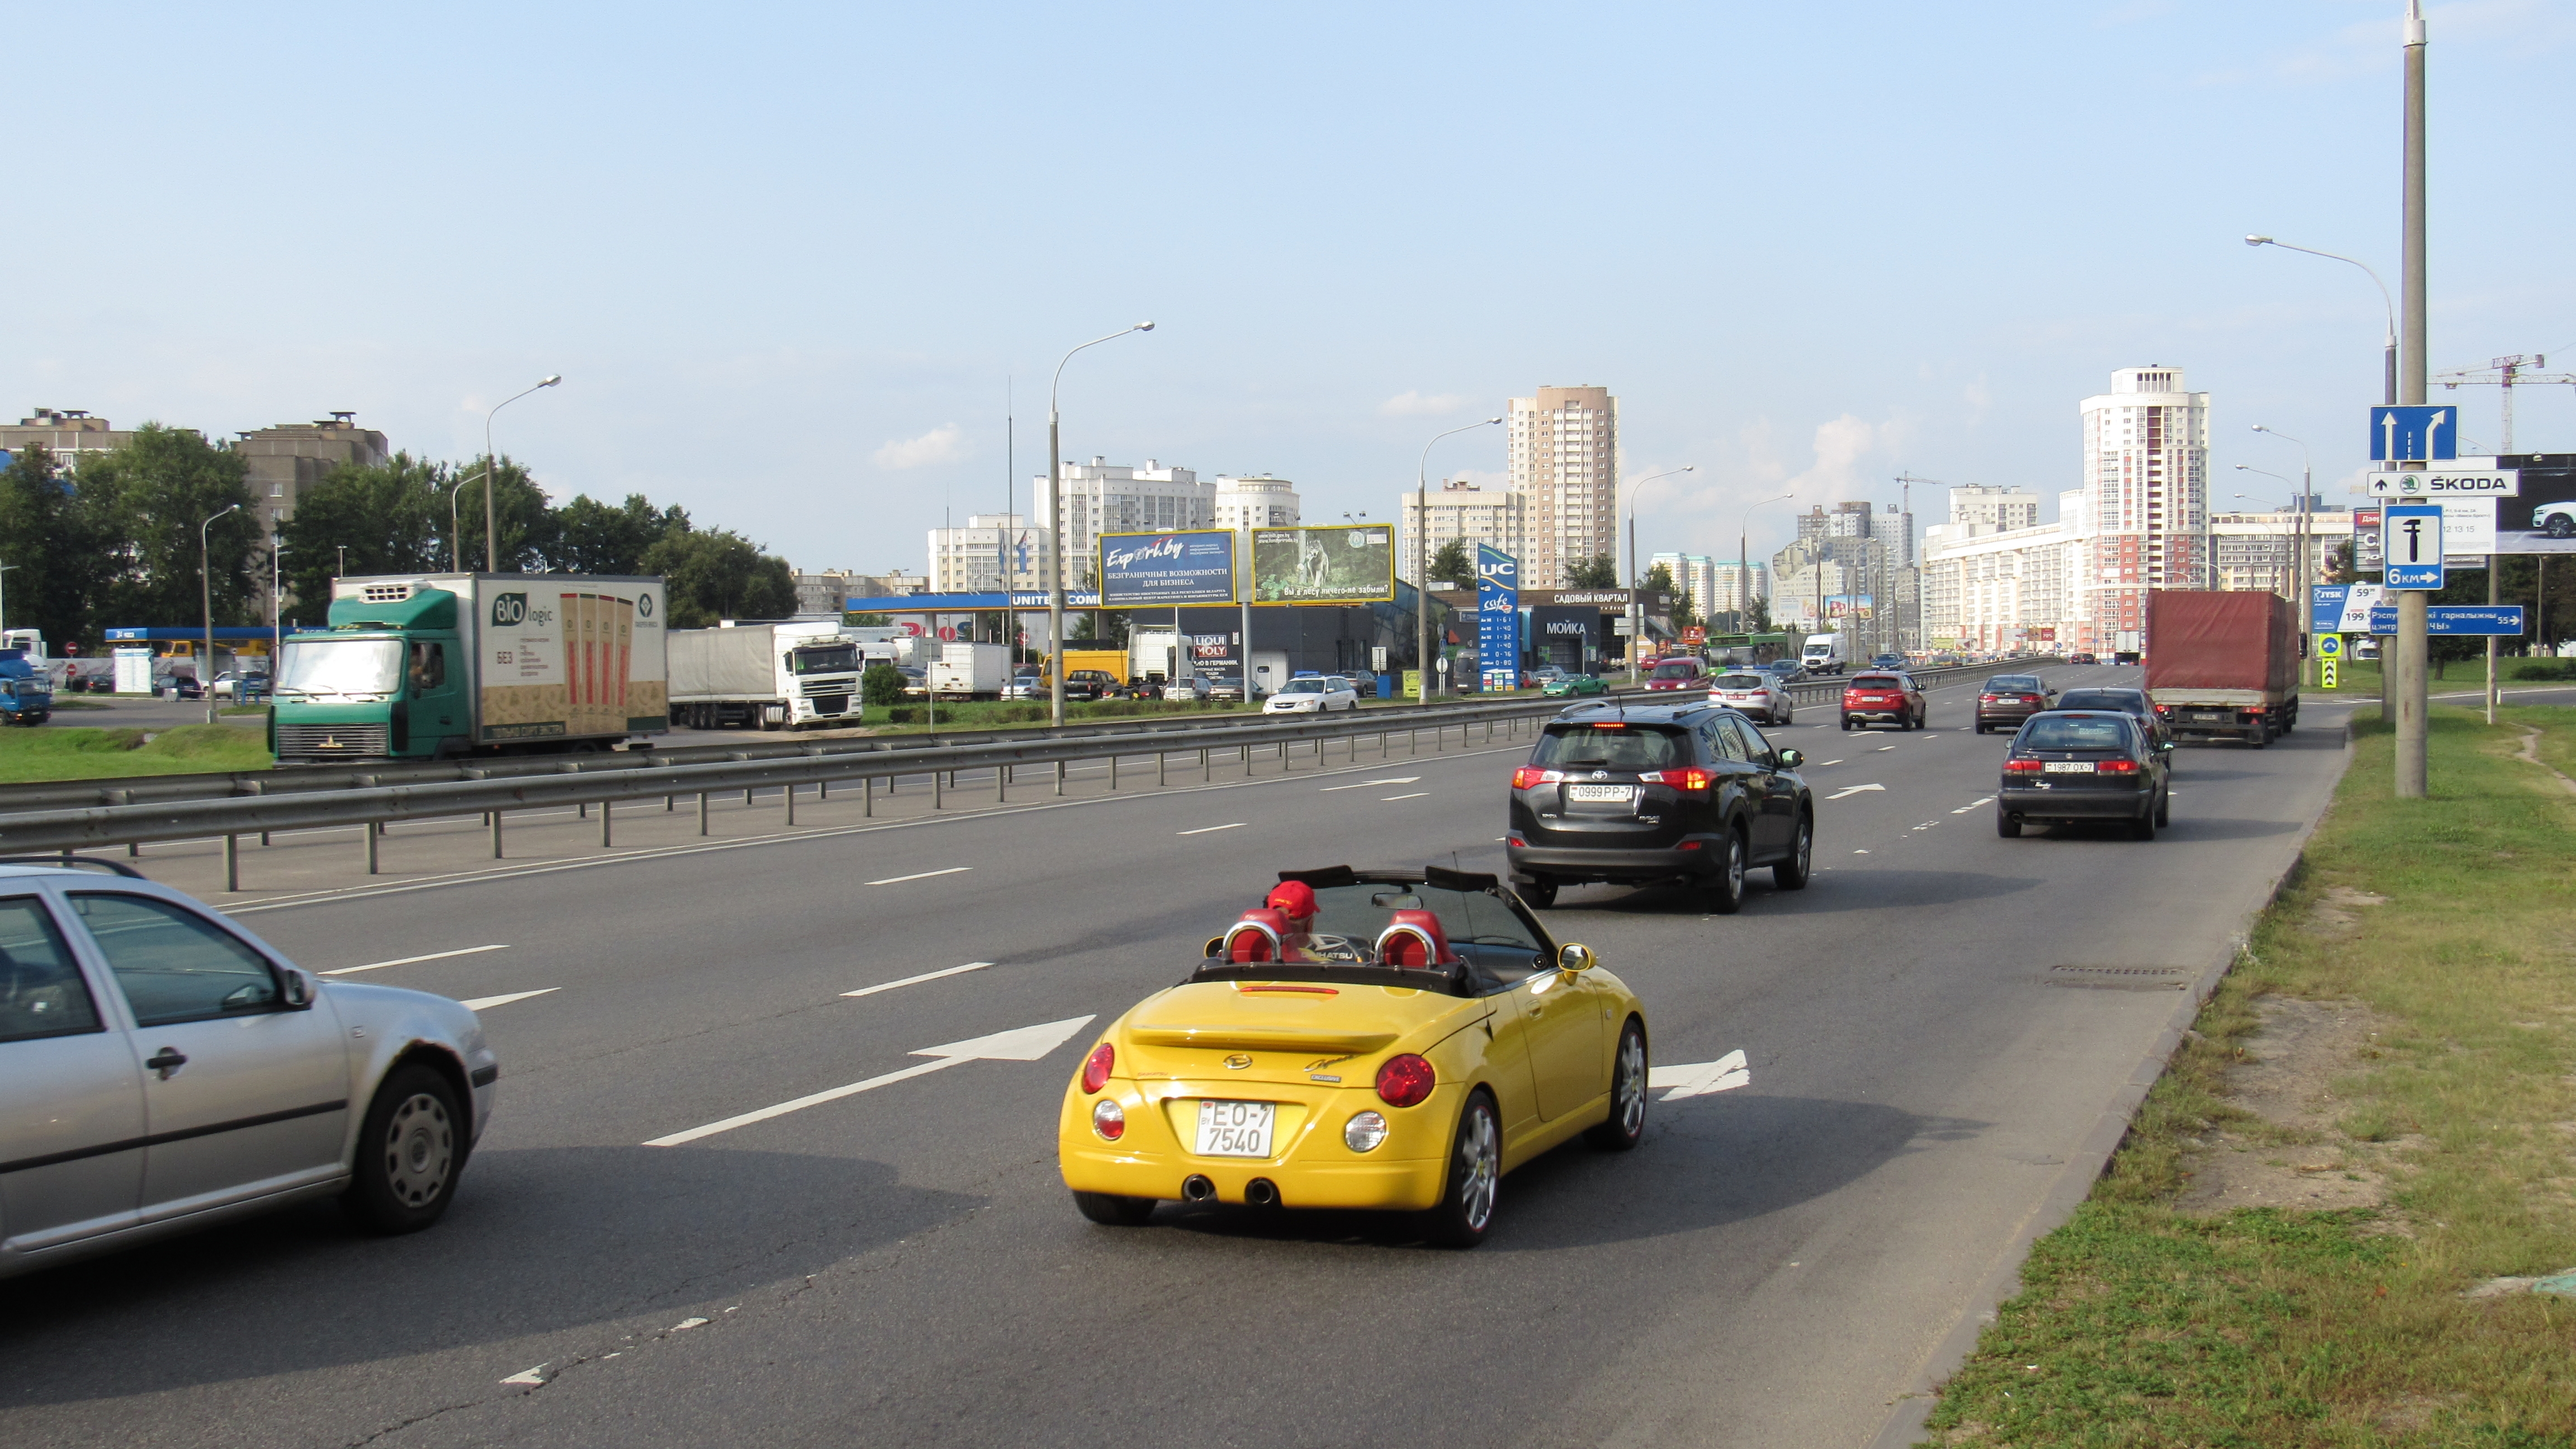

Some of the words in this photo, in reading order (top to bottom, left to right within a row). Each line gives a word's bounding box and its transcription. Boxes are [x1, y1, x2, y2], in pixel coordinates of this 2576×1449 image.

[2431, 476, 2507, 490] ŠKODA
[1107, 571, 1168, 579] БЕЗГРАНИЧНЫЕ
[1169, 569, 1228, 577] ВОЗМОЖНОСТИ
[1480, 563, 1514, 576] UC
[1303, 588, 1319, 596] лесу
[1358, 584, 1389, 593] забыли?
[2356, 589, 2369, 597] 59
[1012, 595, 1050, 605] UNITE
[1483, 593, 1508, 612] cafe
[1554, 592, 1592, 604] САДОВЫЙ
[1594, 594, 1628, 603] КВАРТАЛ
[528, 605, 552, 627] logic
[1546, 619, 1586, 634] МОЙКА
[1196, 637, 1225, 646] LIQUI
[1197, 646, 1226, 655] MOLY
[497, 651, 513, 664] БЕЗ
[1579, 787, 1602, 797] 0999
[1604, 787, 1631, 798] PP-7
[1213, 1102, 1272, 1127] EO-7
[1208, 1128, 1260, 1153] 7540
